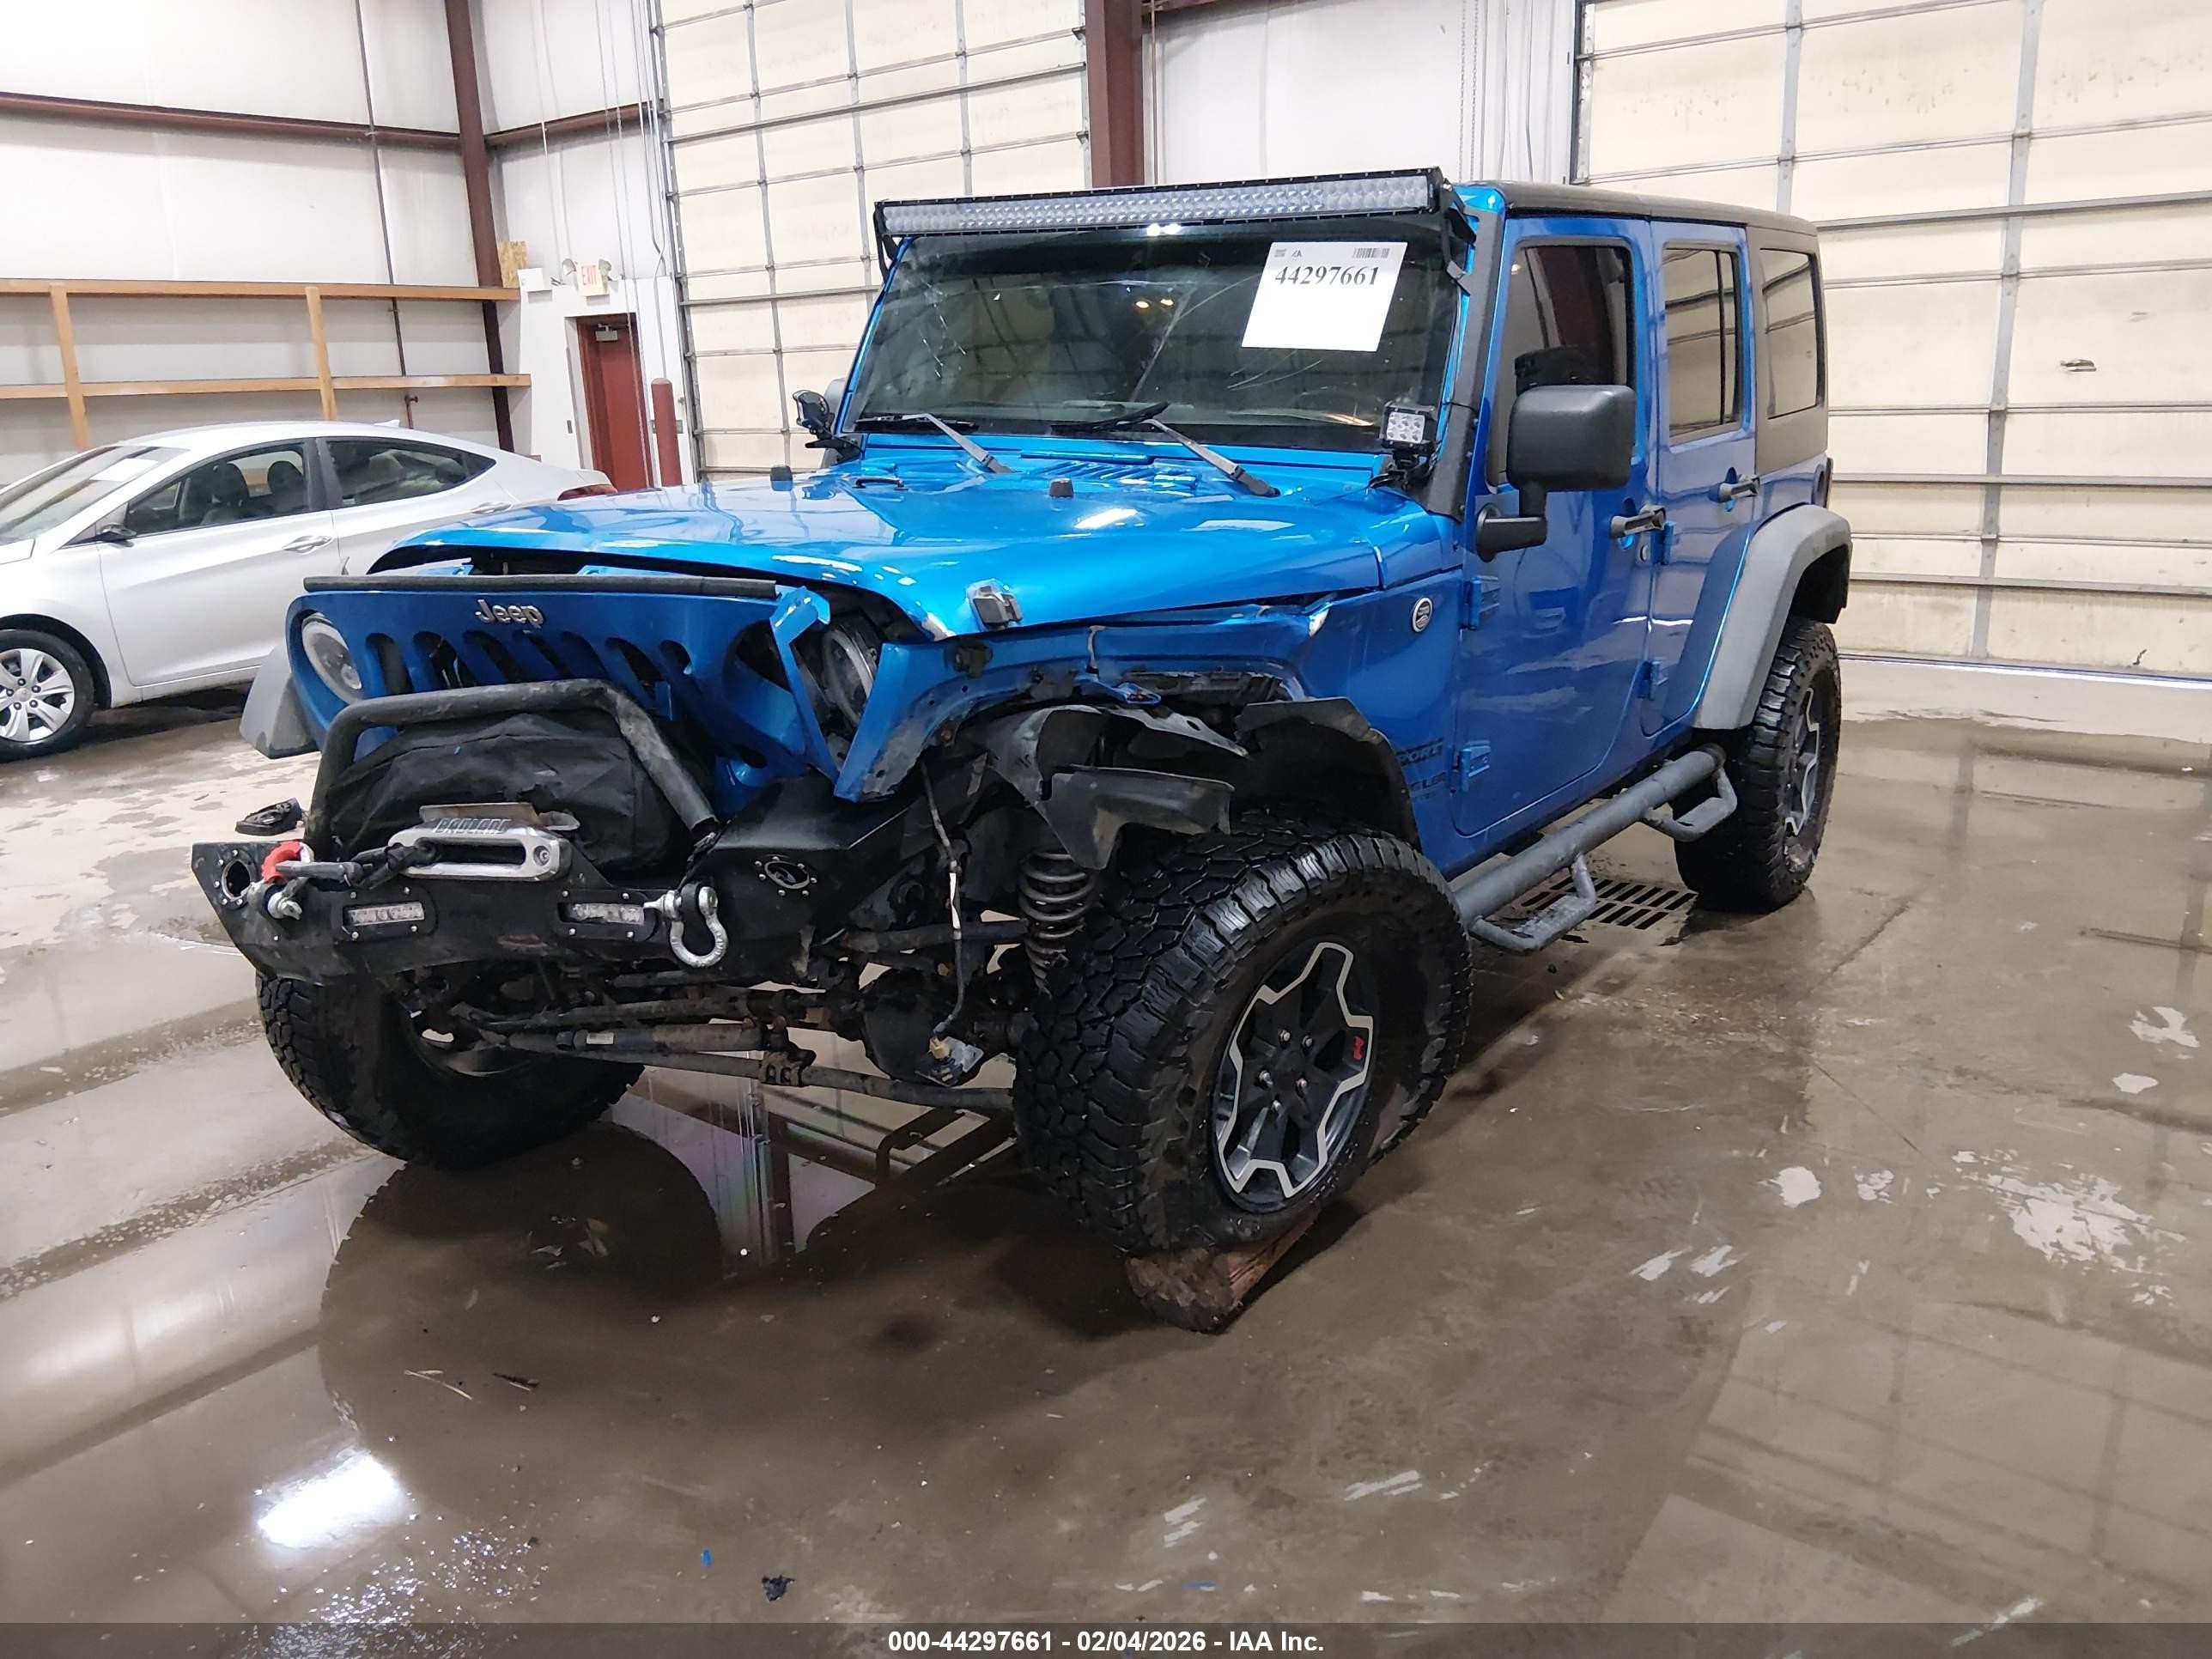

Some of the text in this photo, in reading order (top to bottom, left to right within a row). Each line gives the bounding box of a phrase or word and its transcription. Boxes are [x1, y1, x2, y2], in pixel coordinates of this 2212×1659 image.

[580, 264, 599, 286] EXIT
[1274, 265, 1379, 285] 44297661
[475, 599, 544, 629] Jeep
